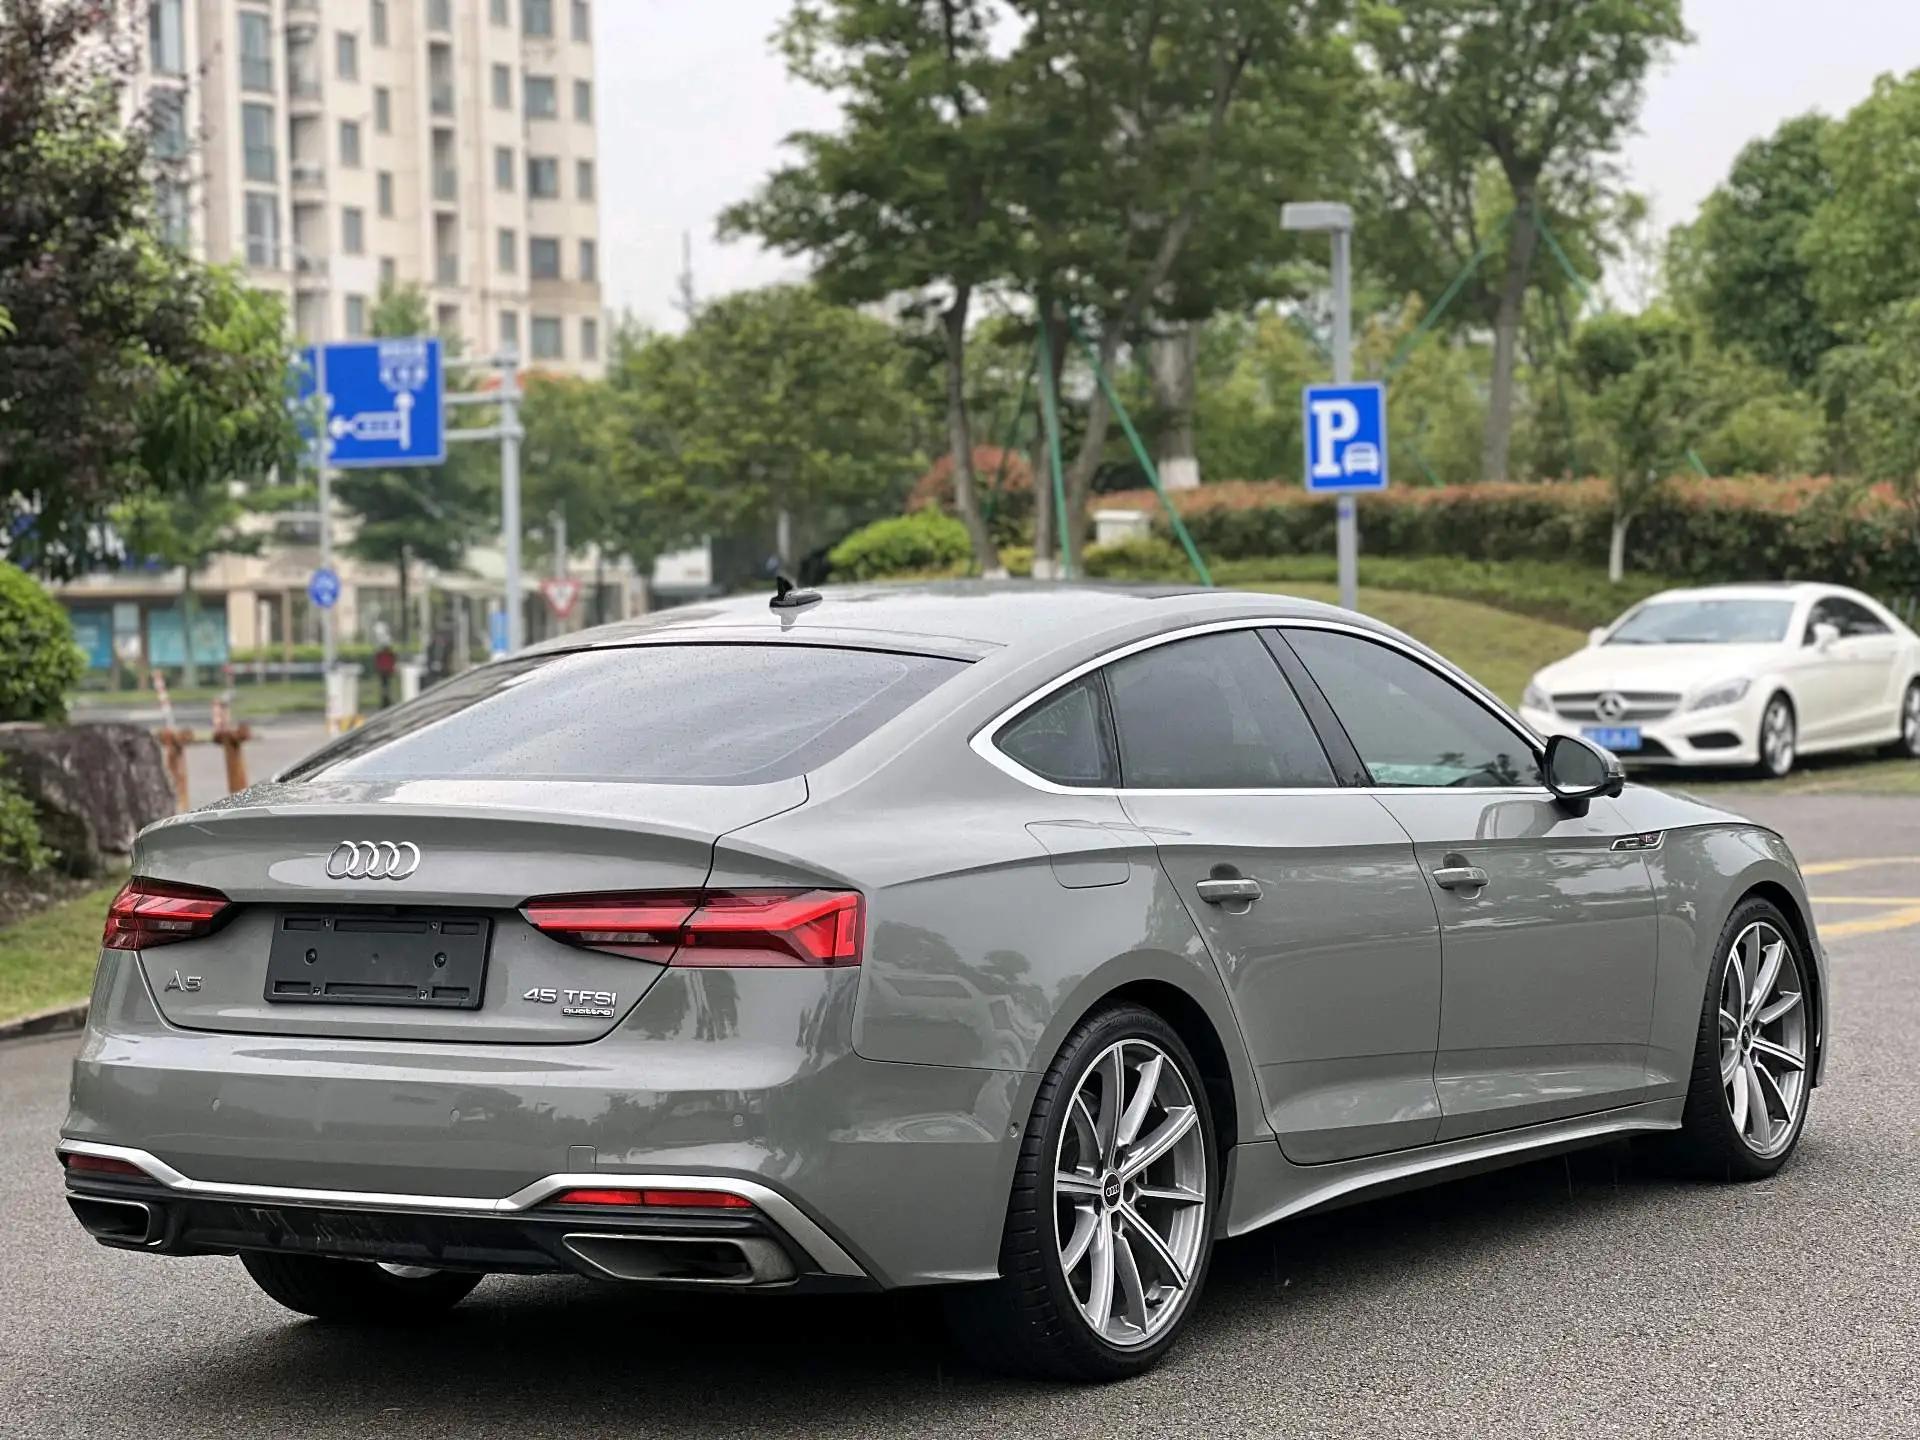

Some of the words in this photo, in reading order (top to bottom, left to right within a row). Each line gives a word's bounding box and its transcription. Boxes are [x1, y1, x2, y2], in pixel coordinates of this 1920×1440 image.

[1312, 399, 1359, 478] P
[164, 969, 202, 992] A5
[523, 987, 557, 1003] 45
[563, 989, 617, 1007] TFSI
[563, 1008, 611, 1016] quattro
